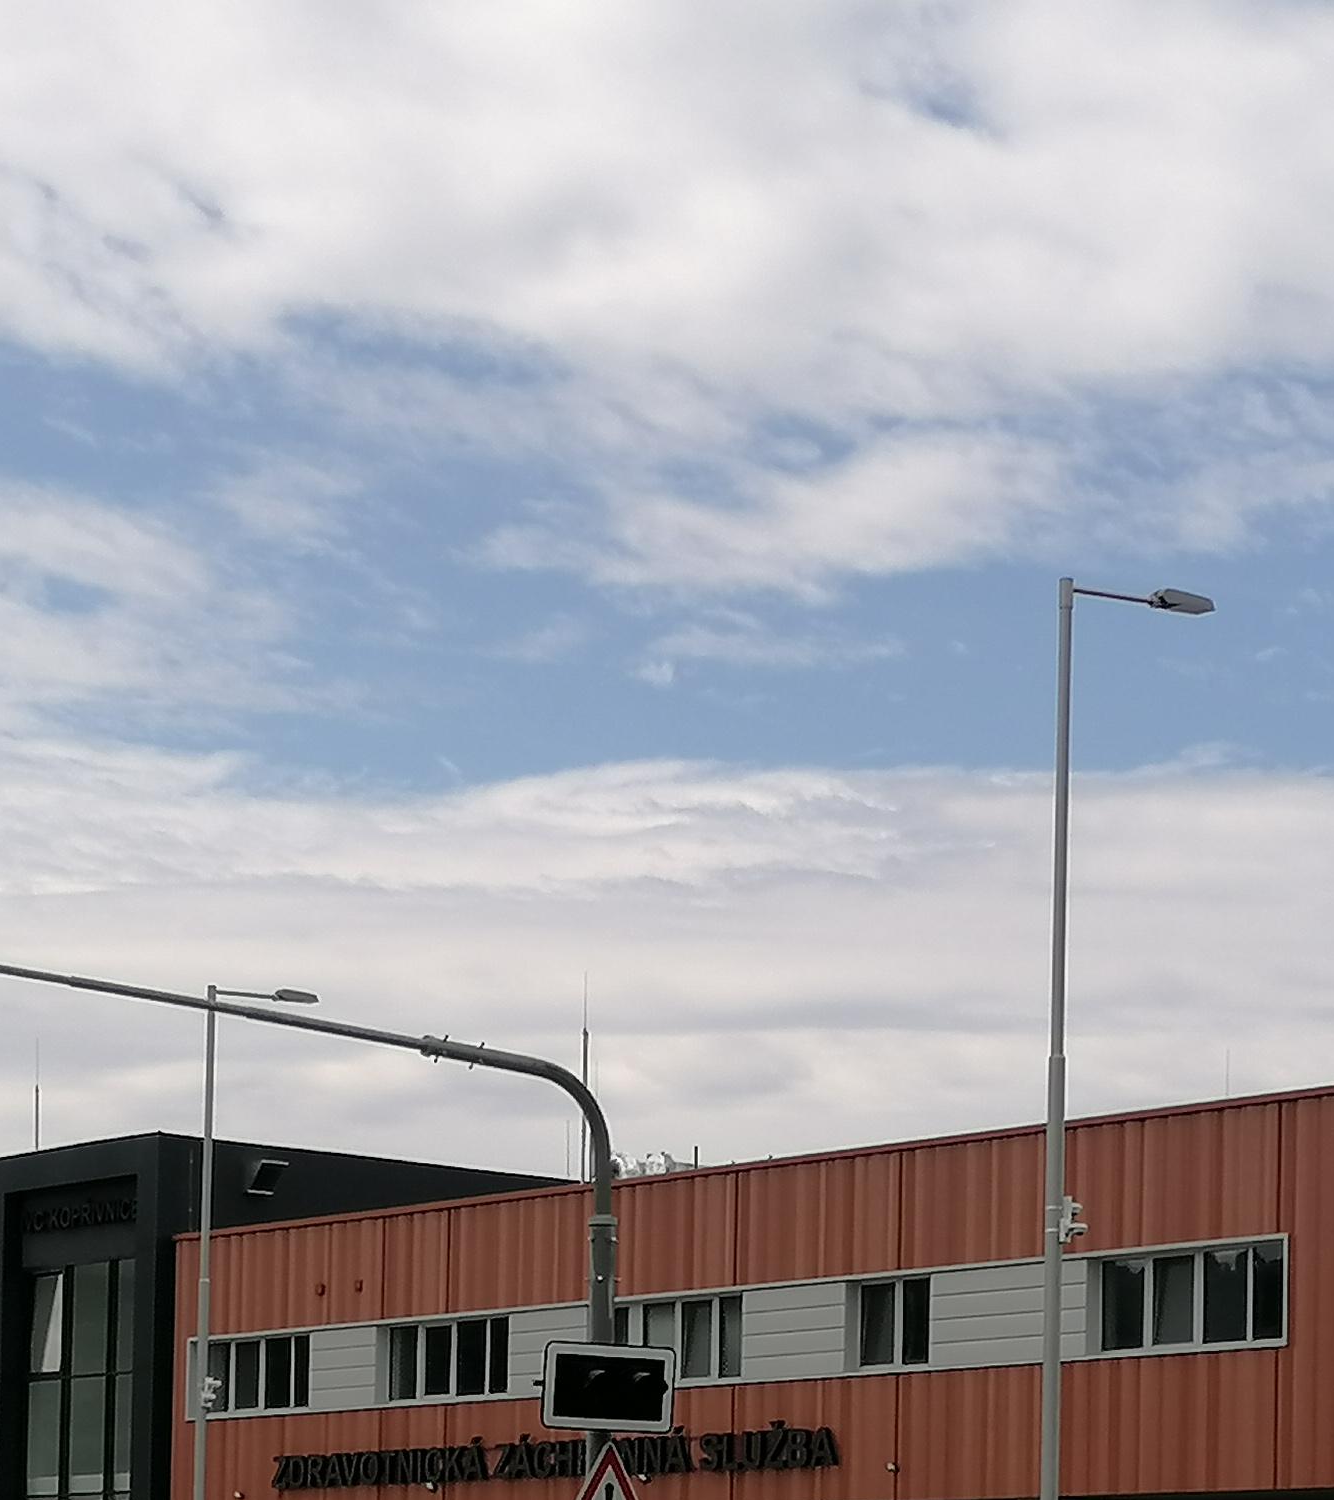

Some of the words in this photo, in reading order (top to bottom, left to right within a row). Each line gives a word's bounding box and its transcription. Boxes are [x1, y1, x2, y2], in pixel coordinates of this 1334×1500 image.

[272, 1436, 491, 1489] ZDRAVOTNICKÁ
[493, 1425, 697, 1480] ZÁCHNNÁ
[699, 1420, 840, 1472] SLUŽBA
